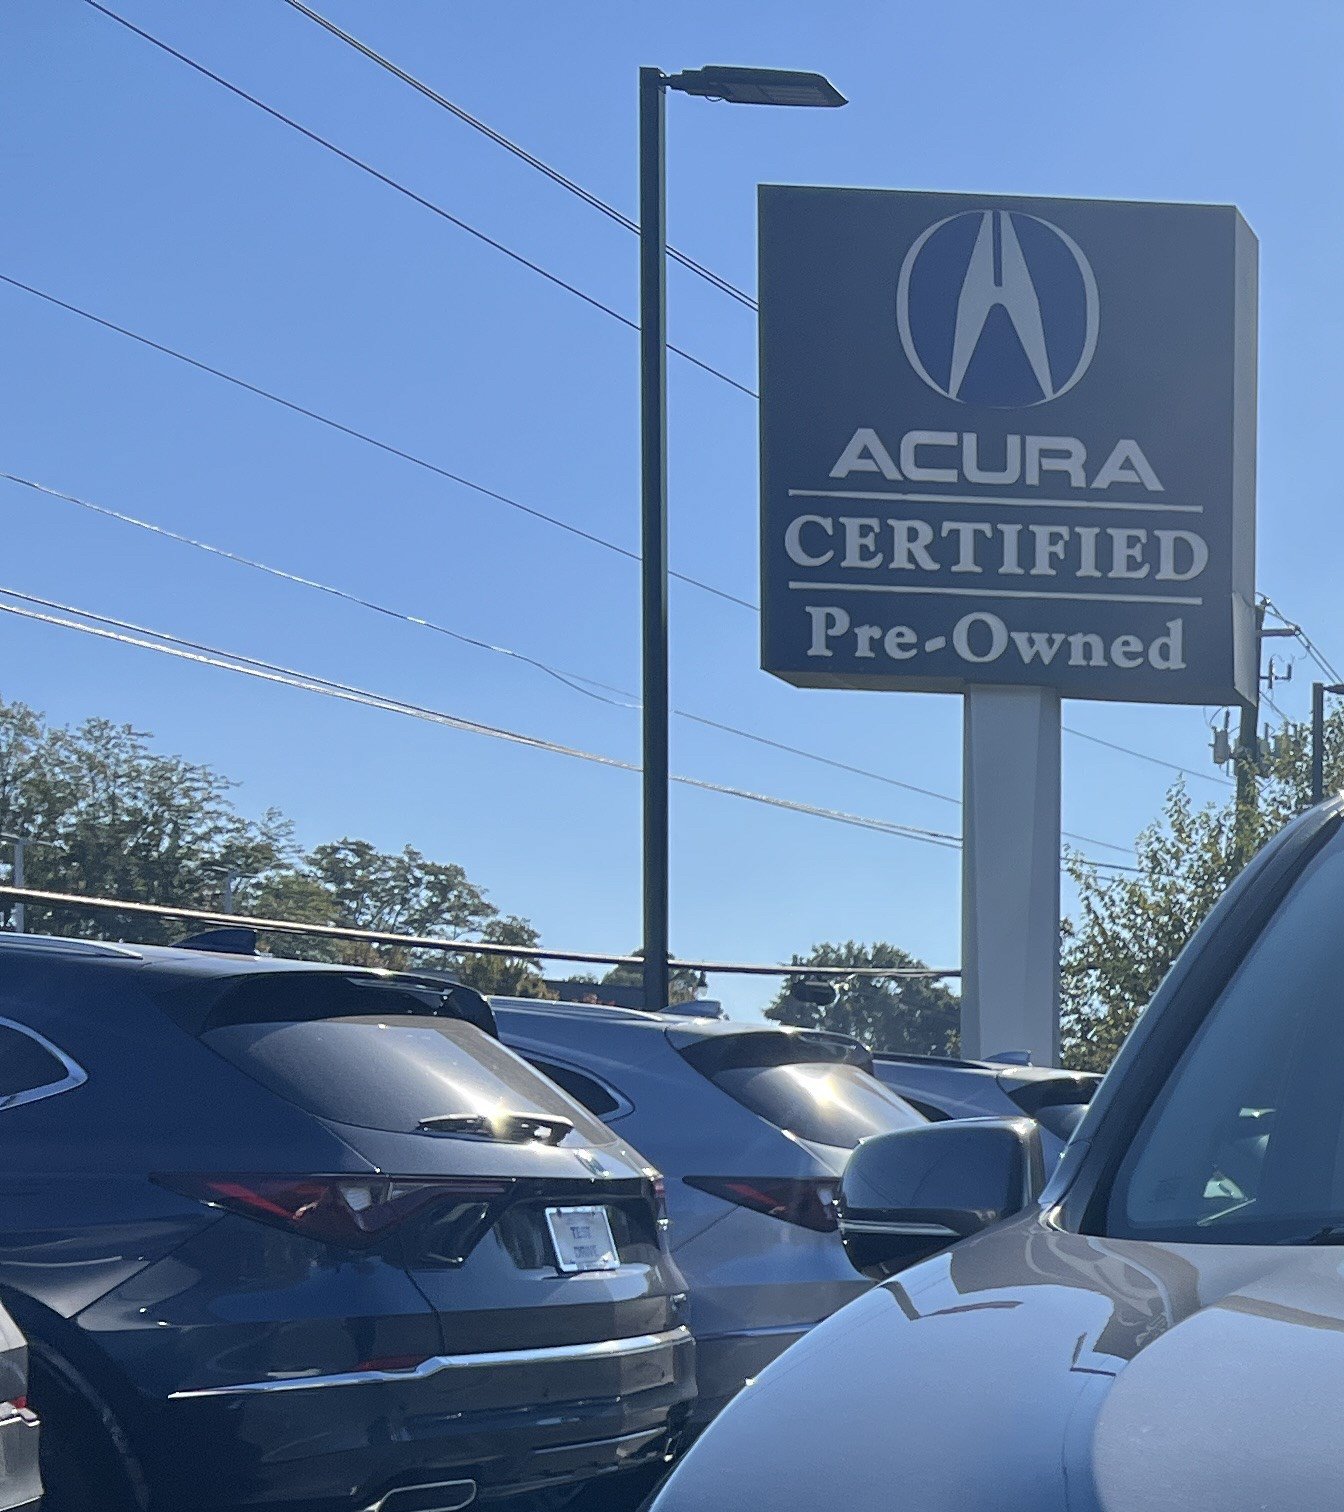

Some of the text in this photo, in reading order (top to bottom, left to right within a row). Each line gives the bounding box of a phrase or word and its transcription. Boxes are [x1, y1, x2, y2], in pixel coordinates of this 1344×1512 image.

[828, 427, 1165, 491] ACURA
[784, 514, 1210, 582] CERTIFIED
[804, 604, 1187, 671] Pre-Owned
